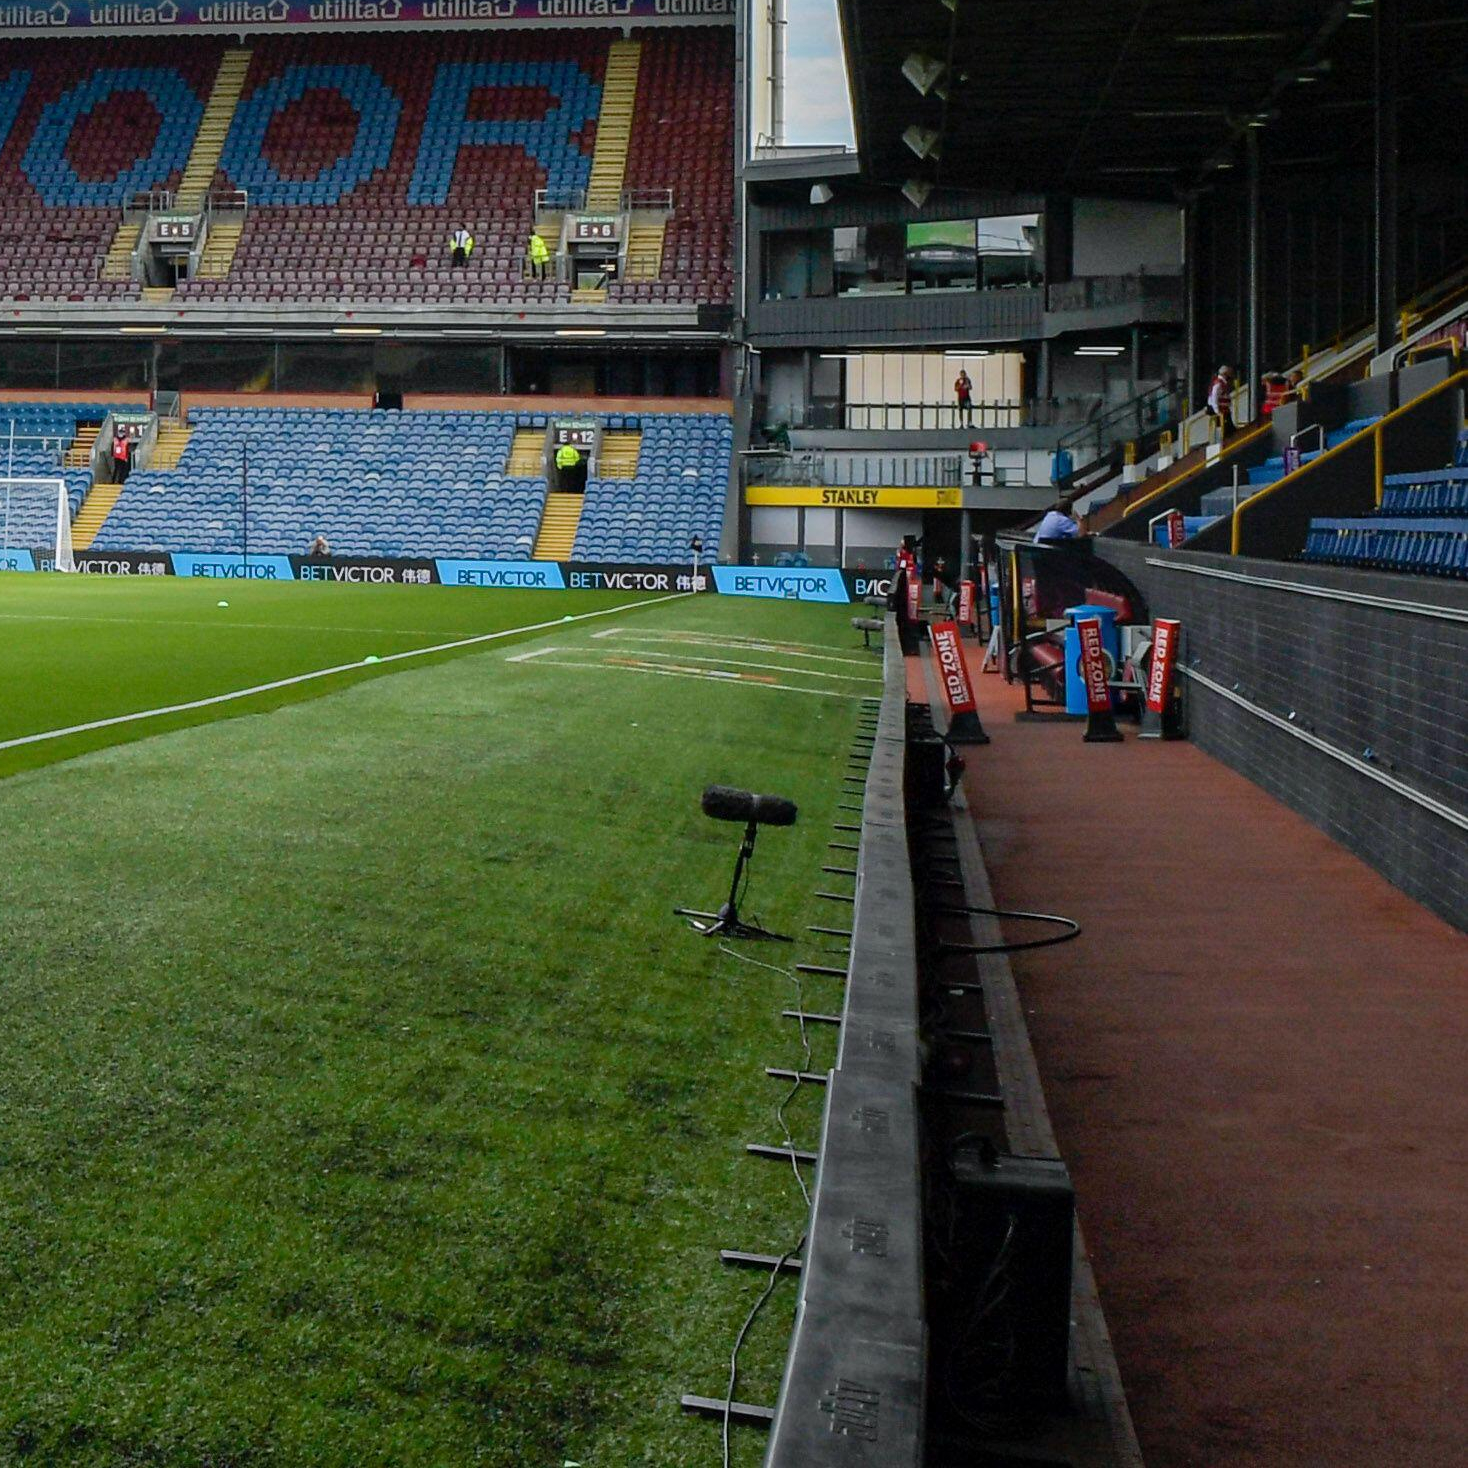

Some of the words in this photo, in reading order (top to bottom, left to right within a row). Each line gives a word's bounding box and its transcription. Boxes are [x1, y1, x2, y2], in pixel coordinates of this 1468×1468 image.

[89, 3, 156, 25] utilita
[198, 1, 265, 23] utilita
[161, 224, 168, 235] E
[182, 224, 189, 235] 5
[580, 224, 588, 236] E
[602, 224, 610, 236] 6
[559, 430, 567, 442] E
[580, 430, 594, 442] 12
[822, 489, 878, 504] STANLEY
[41, 559, 130, 574] BEVICTOR
[192, 563, 276, 579] BETVICTOR
[300, 566, 394, 583] BETVICTOR
[458, 569, 546, 586] BETVICTOR
[570, 572, 669, 590] BETVICTOR
[735, 575, 828, 593] BETVICTOR
[1086, 627, 1100, 657] RED
[1157, 628, 1168, 659] RED
[936, 631, 957, 673] ZONE
[948, 675, 963, 705] RED
[1091, 661, 1106, 701] ZONE
[1152, 661, 1164, 702] ZONE
